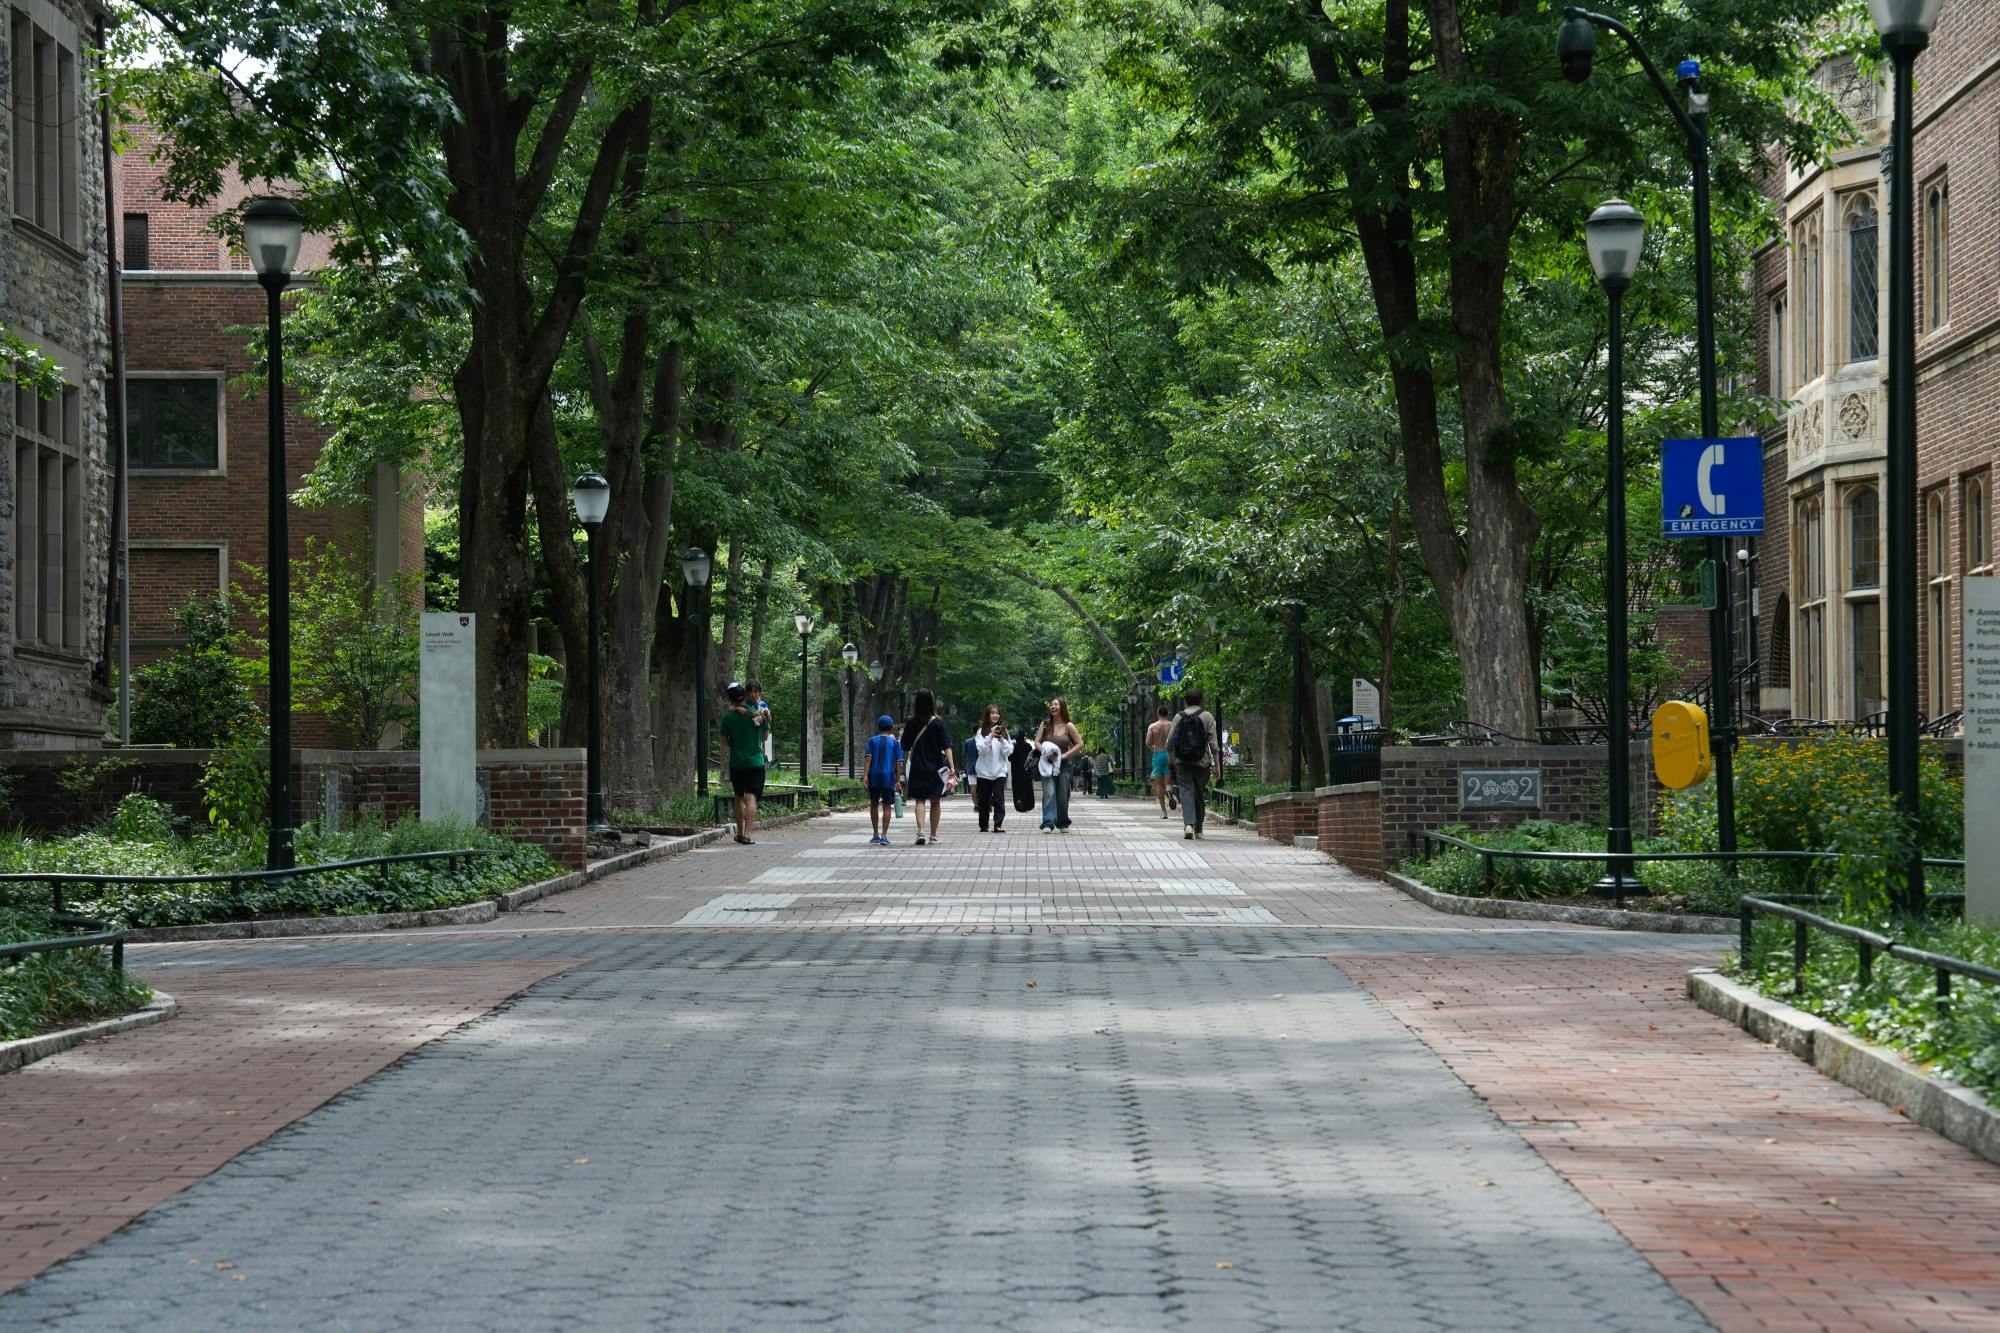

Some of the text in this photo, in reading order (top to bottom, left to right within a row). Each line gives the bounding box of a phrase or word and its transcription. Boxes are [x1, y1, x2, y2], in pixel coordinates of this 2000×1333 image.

[1671, 520, 1756, 531] EMERGENCY
[1977, 692, 1993, 700] The
[1978, 727, 1992, 735] Art
